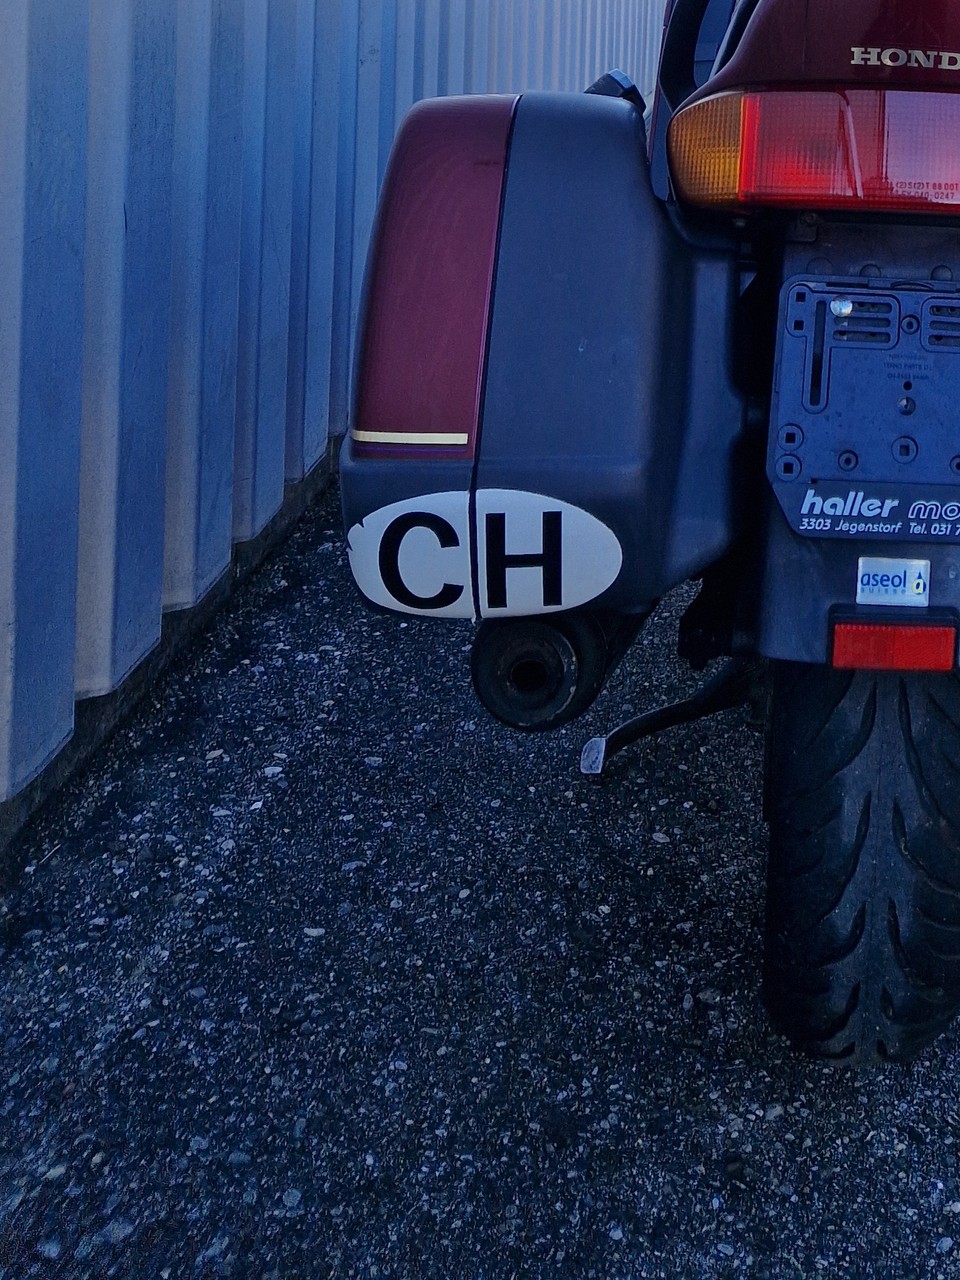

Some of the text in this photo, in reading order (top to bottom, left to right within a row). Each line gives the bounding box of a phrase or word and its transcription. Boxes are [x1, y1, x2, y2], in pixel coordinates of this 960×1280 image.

[800, 489, 900, 518] haller
[799, 518, 832, 530] 3303
[834, 519, 902, 534] Jegenstorf
[909, 522, 928, 535] Tel.
[930, 523, 952, 535] 031
[378, 511, 563, 609] CH
[860, 570, 907, 588] aseol
